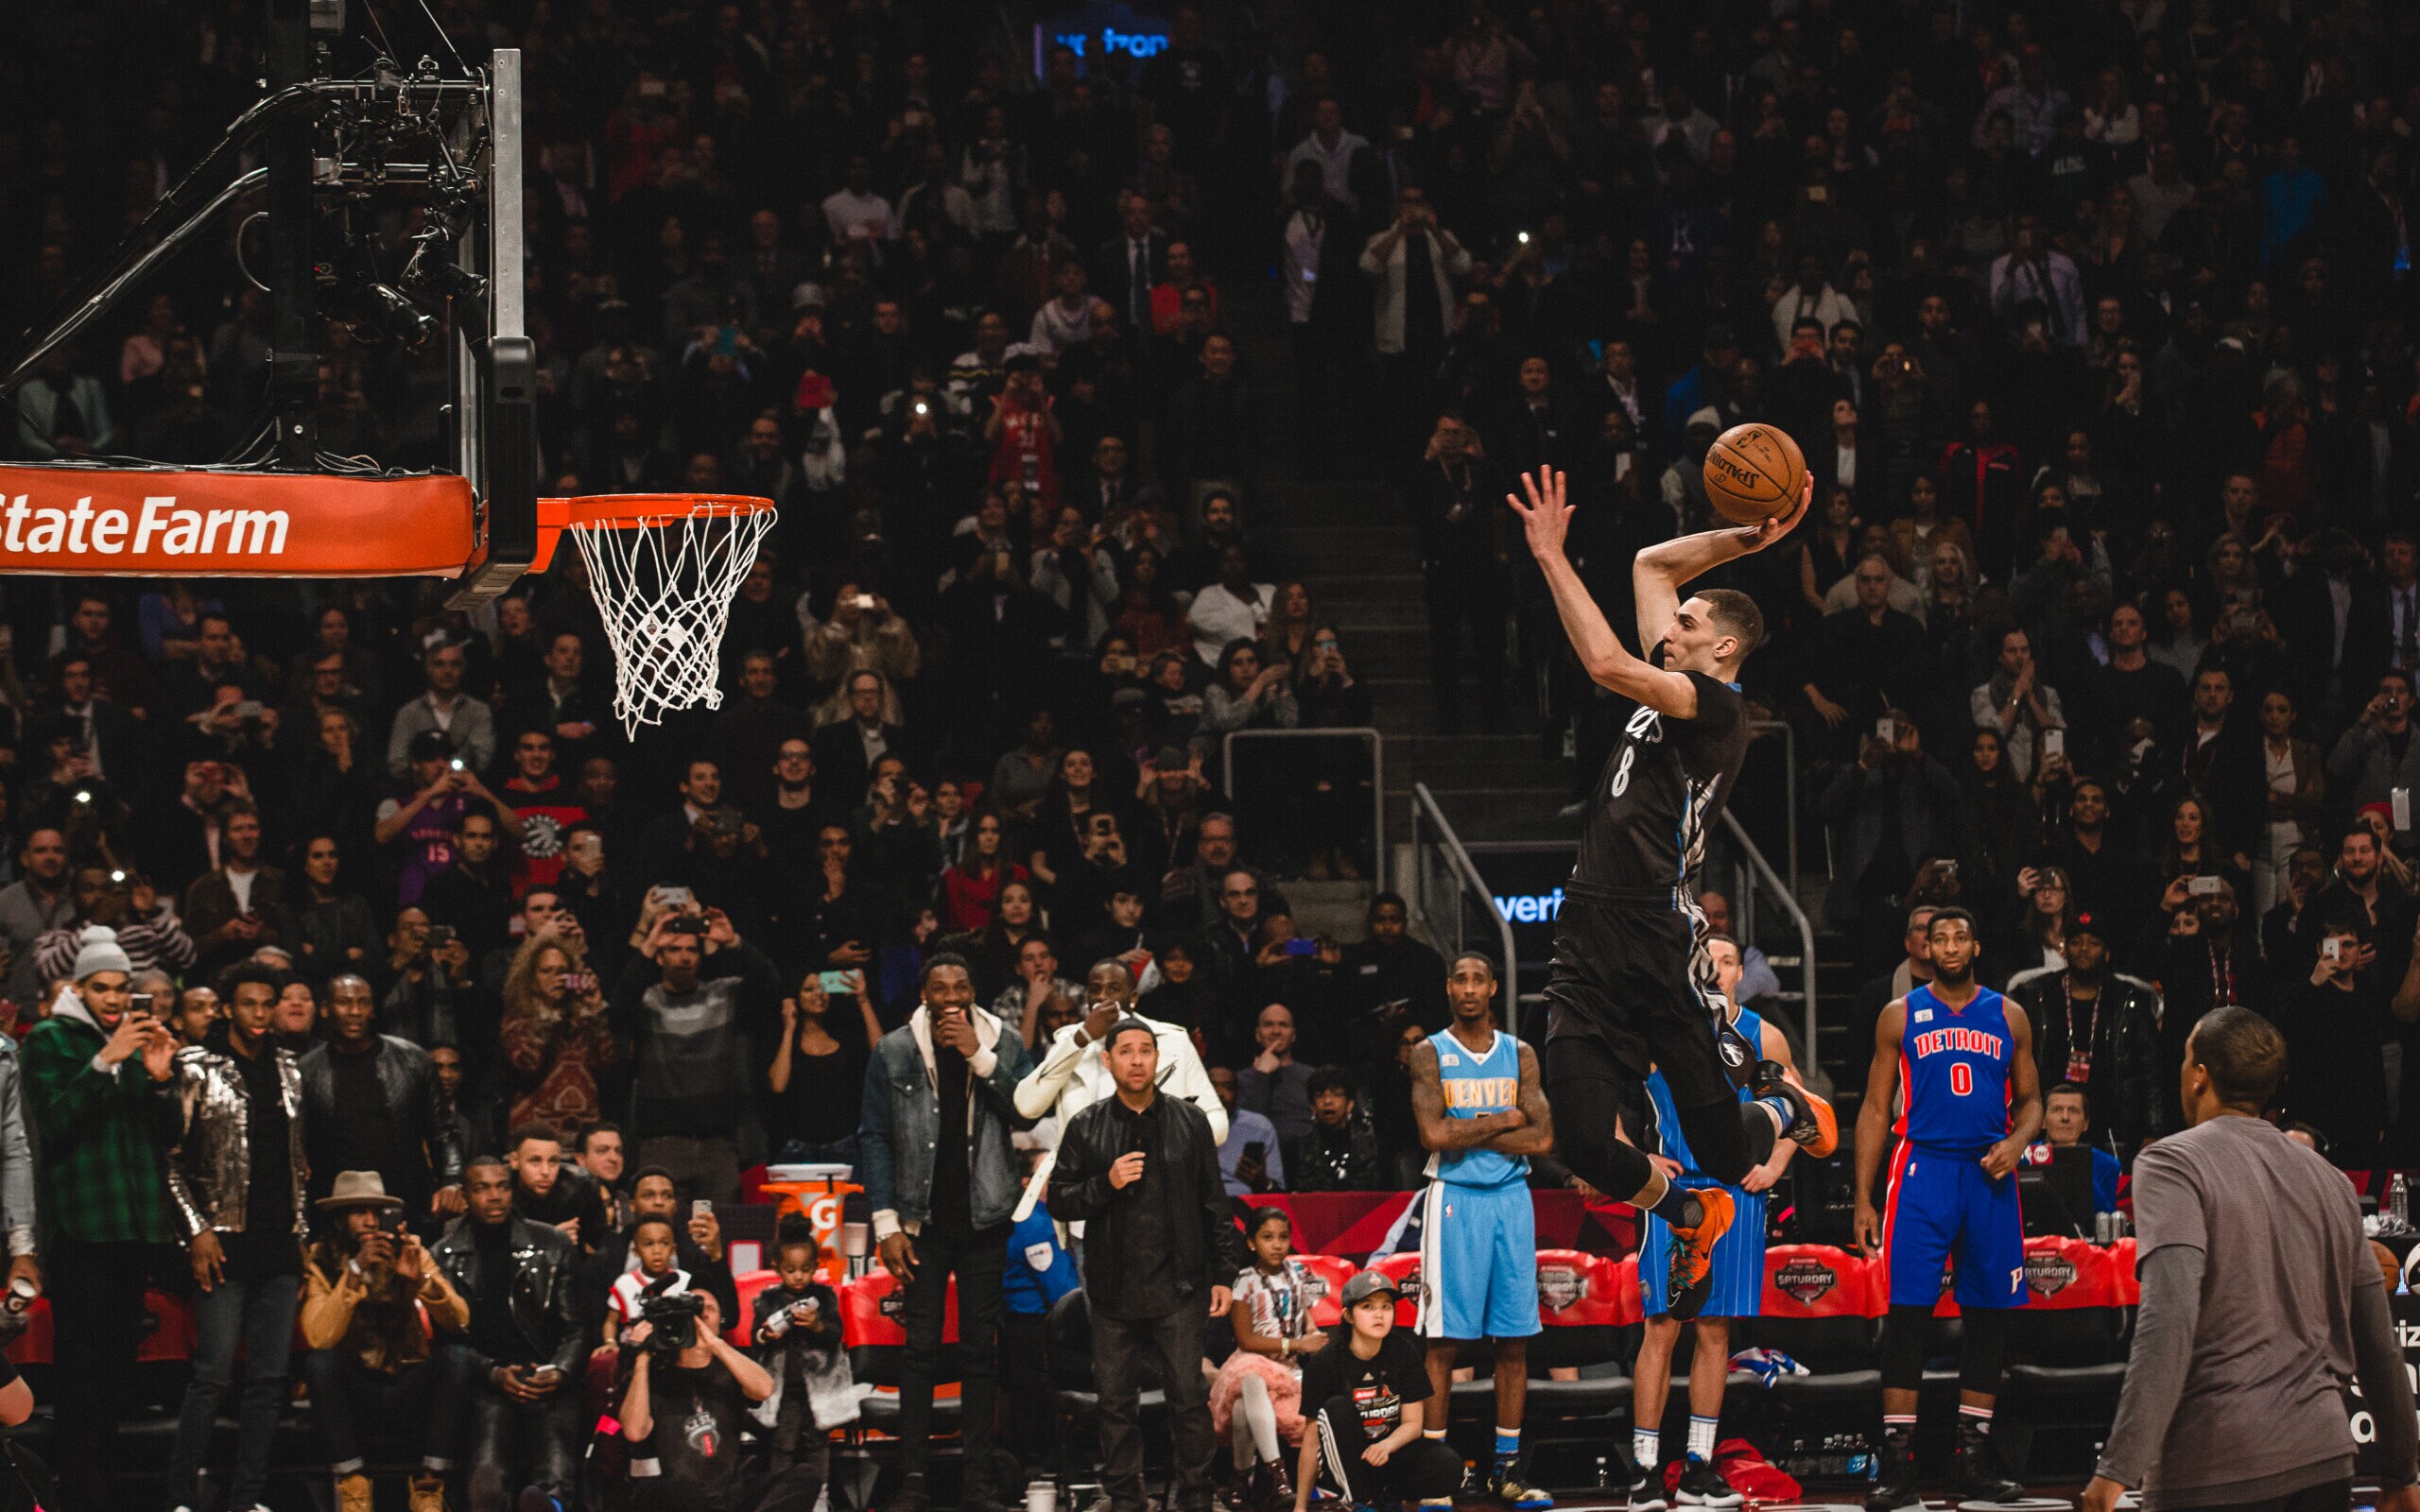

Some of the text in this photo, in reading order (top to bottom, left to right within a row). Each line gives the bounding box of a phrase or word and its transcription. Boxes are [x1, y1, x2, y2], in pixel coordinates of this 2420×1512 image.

[1612, 746, 1634, 799] 8
[1913, 1027, 2002, 1060] DETROIT
[1443, 1079, 1518, 1108] DENVER
[1950, 1062, 1973, 1096] 0
[811, 1198, 838, 1230] G
[1777, 1273, 1833, 1285] SATURDAY
